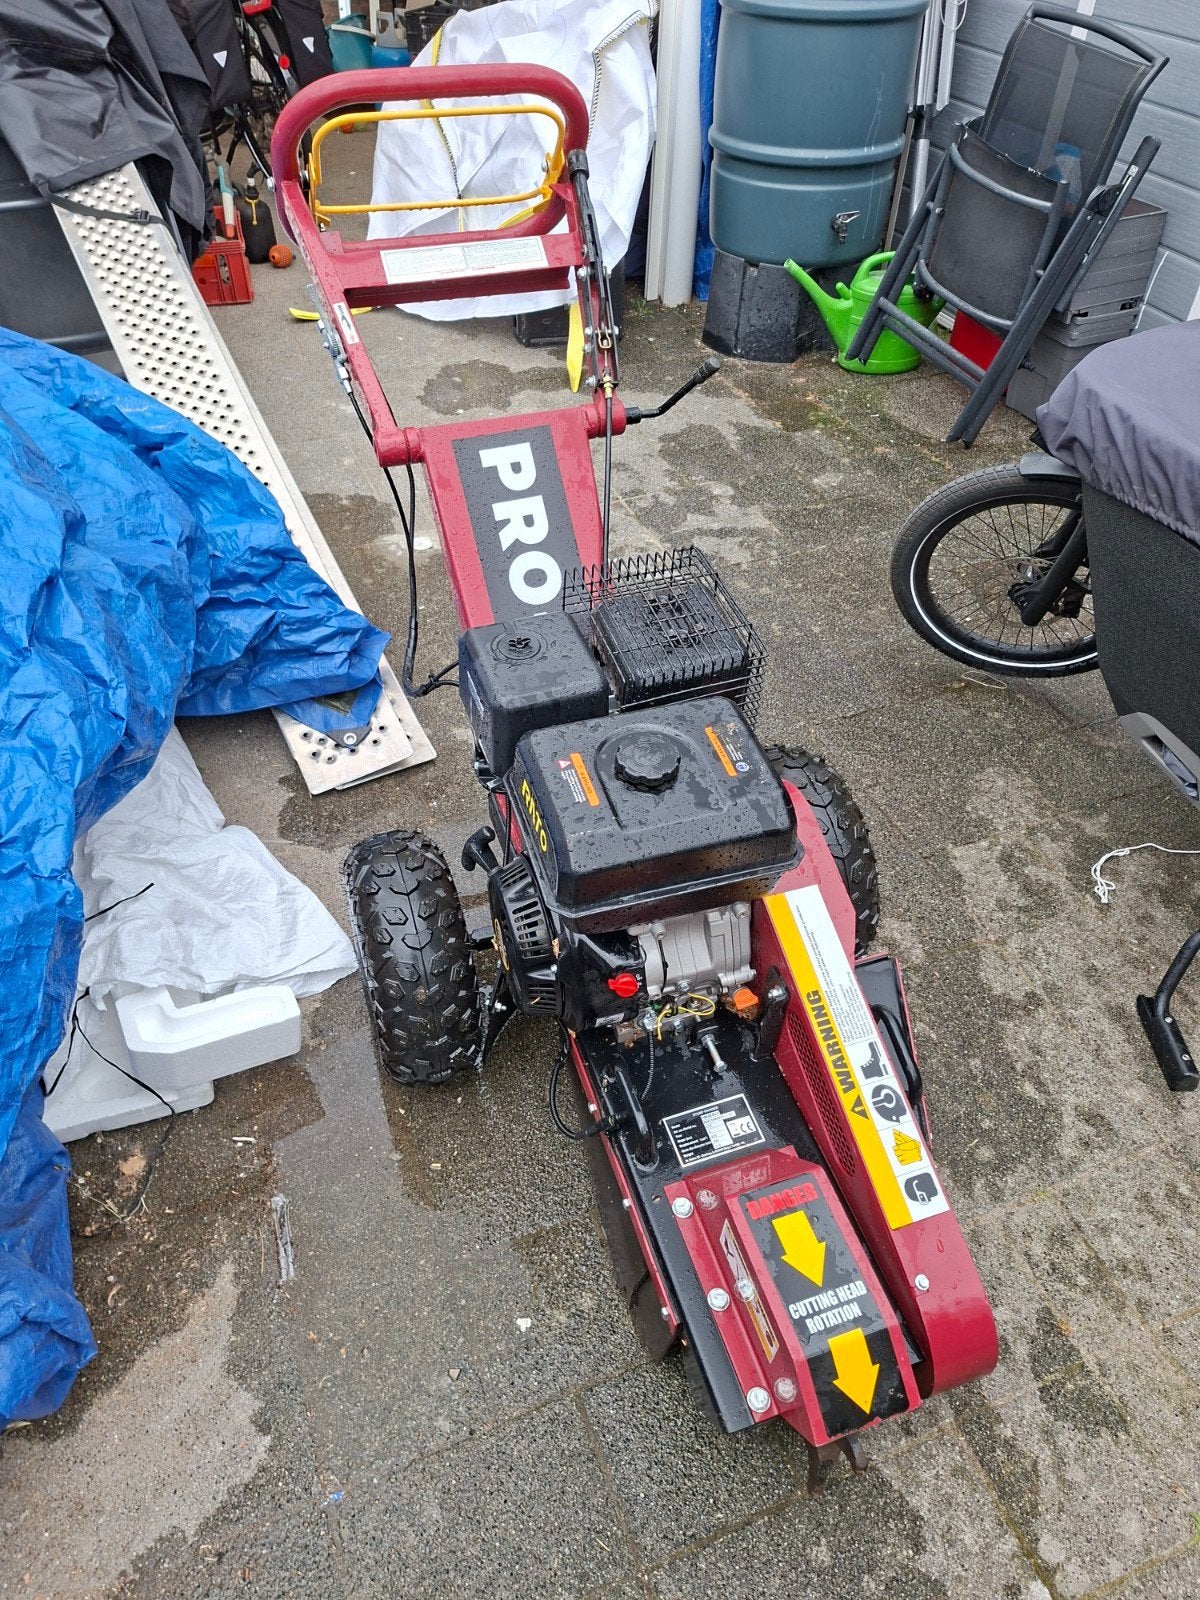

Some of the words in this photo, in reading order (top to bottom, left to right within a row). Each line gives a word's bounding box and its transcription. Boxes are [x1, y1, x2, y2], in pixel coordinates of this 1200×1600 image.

[479, 442, 562, 605] PRO
[522, 779, 547, 852] RATO
[806, 989, 856, 1094] WARNING
[746, 1182, 819, 1221] DANGER
[788, 1290, 839, 1320] CUTTING
[837, 1280, 868, 1304] HEAD
[805, 1302, 863, 1334] ROTATION
